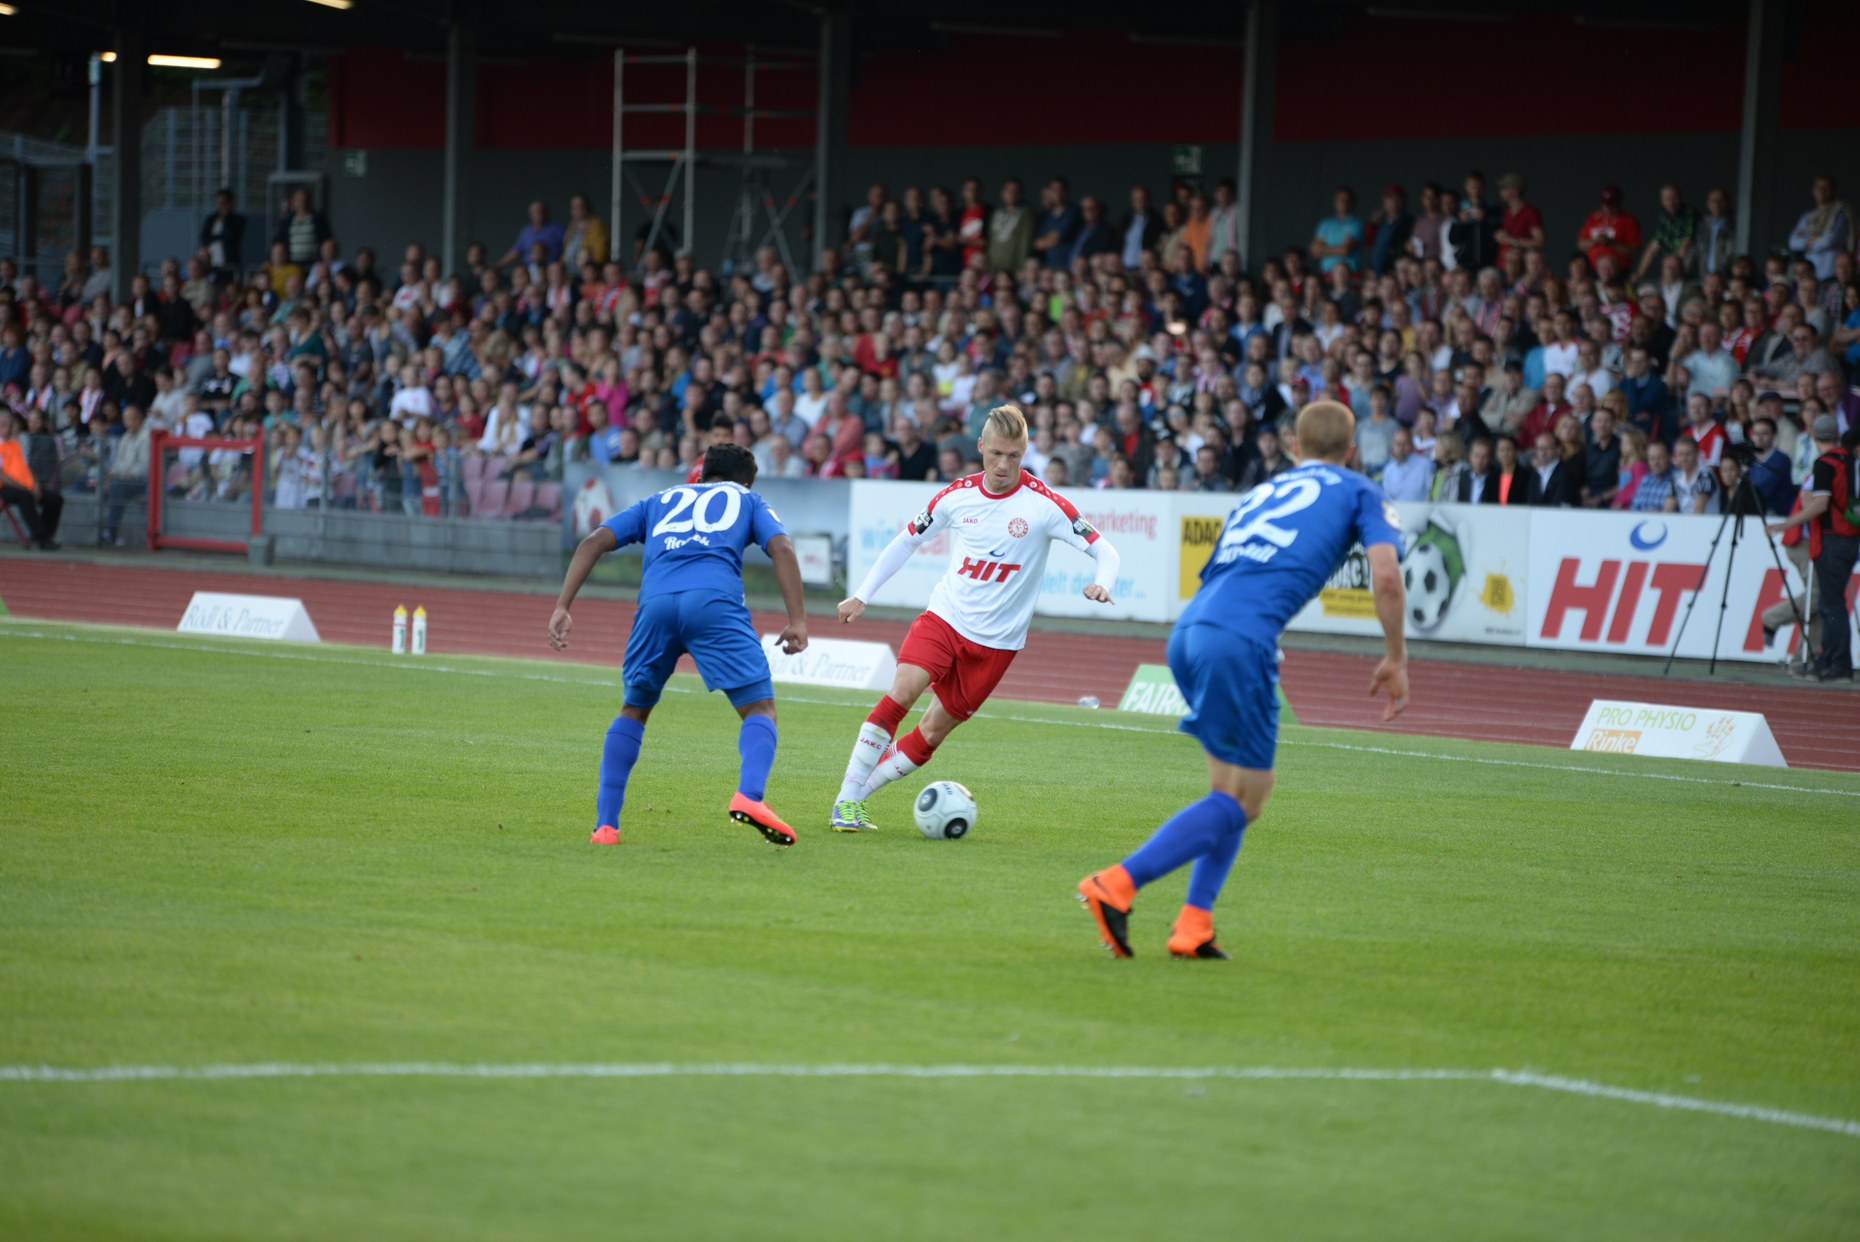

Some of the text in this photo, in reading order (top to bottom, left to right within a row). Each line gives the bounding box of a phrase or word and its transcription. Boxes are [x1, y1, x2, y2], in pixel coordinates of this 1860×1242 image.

[652, 486, 741, 537] 20
[1220, 478, 1321, 548] 22
[1183, 520, 1222, 546] ADAC
[956, 557, 1021, 582] HIT
[1540, 557, 1710, 647] HIT
[232, 608, 285, 636] Partner
[810, 653, 872, 682] Partner
[1596, 707, 1697, 731] PRO PHYSIO
[860, 737, 882, 750] JAKO
[1586, 729, 1637, 753] Rinke
